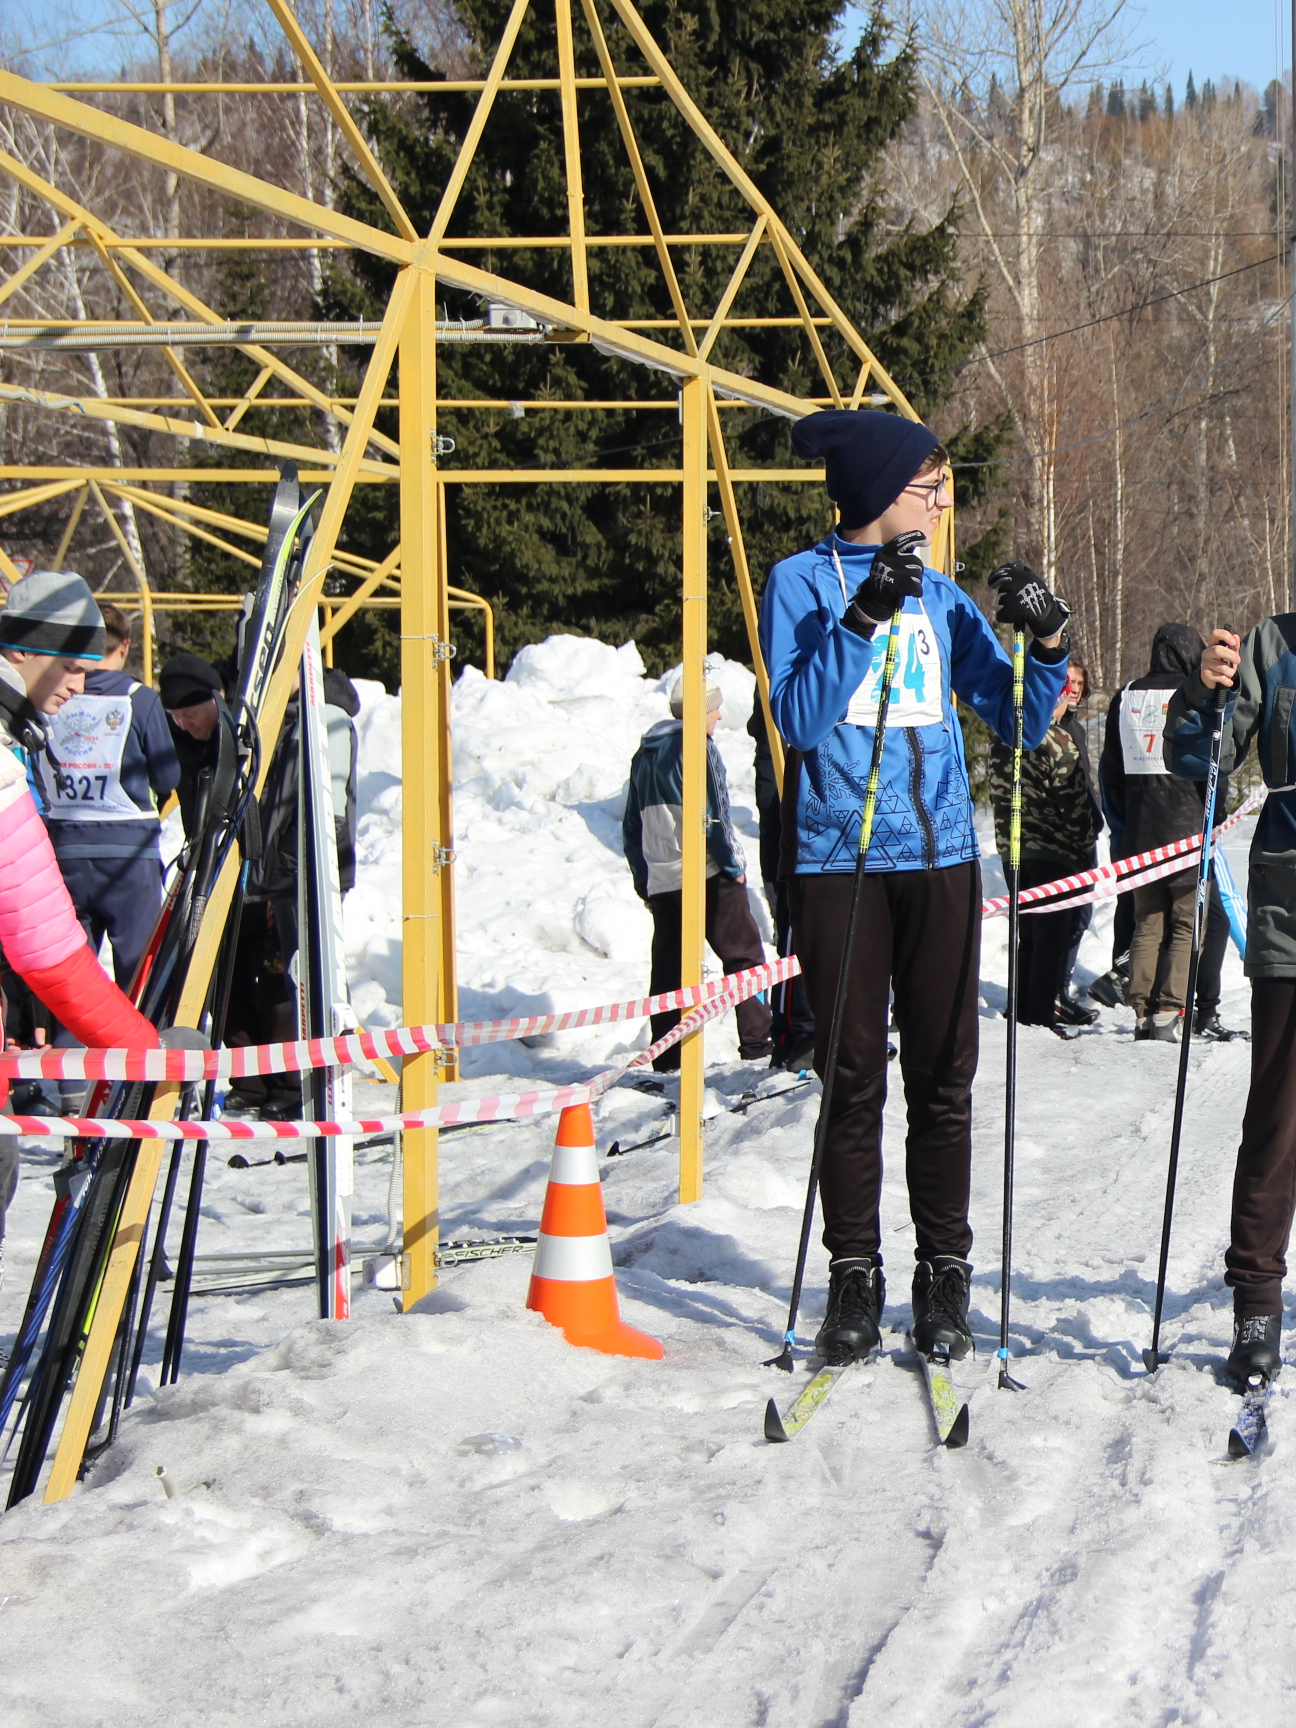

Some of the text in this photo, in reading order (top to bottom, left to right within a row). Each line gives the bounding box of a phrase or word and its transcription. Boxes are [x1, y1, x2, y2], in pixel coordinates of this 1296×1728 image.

[917, 629, 931, 656] 3
[870, 633, 926, 704] 24
[1143, 733, 1157, 753] 7
[54, 774, 108, 802] 1327
